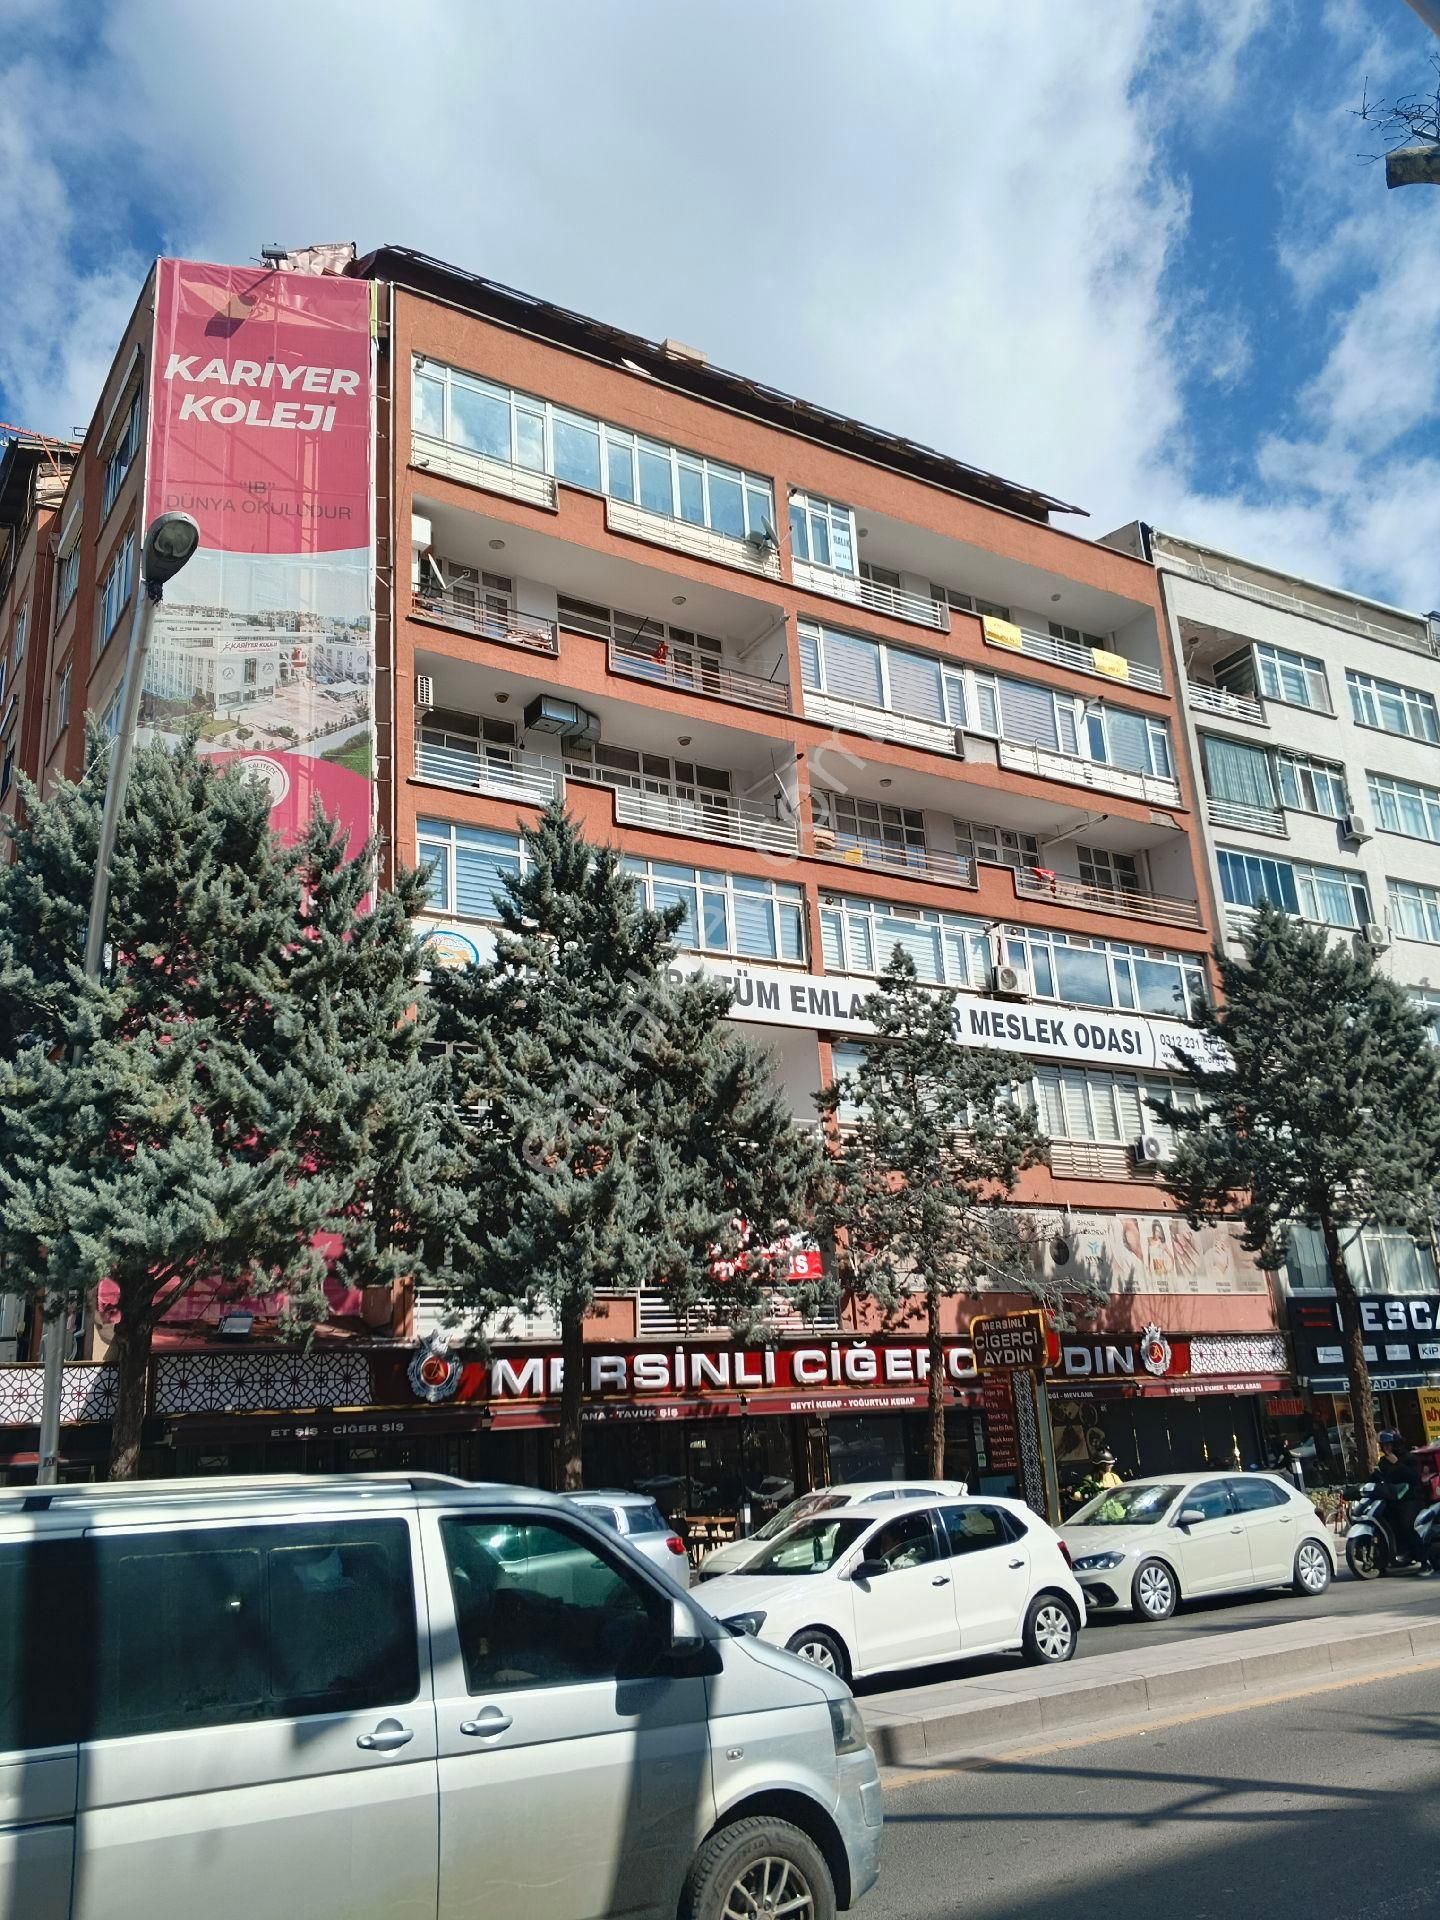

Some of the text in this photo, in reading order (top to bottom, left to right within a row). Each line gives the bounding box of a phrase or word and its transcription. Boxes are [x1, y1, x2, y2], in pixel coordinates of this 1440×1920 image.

[162, 353, 361, 396] KARİYER
[178, 393, 338, 433] KOLEJİ
[166, 492, 352, 520] DÜNYA OKULUDUR
[969, 1009, 1067, 1047] MESLEK
[1074, 1021, 1143, 1056] ODASI
[981, 1316, 1027, 1332] MERSİNLİ
[983, 1347, 1033, 1367] AYDIN
[816, 1399, 842, 1410] KEBAP
[848, 1397, 889, 1408] YOĞURTLU
[890, 1397, 916, 1407] KEBAP
[616, 1409, 657, 1419] TAVUK
[270, 1429, 290, 1437] ET
